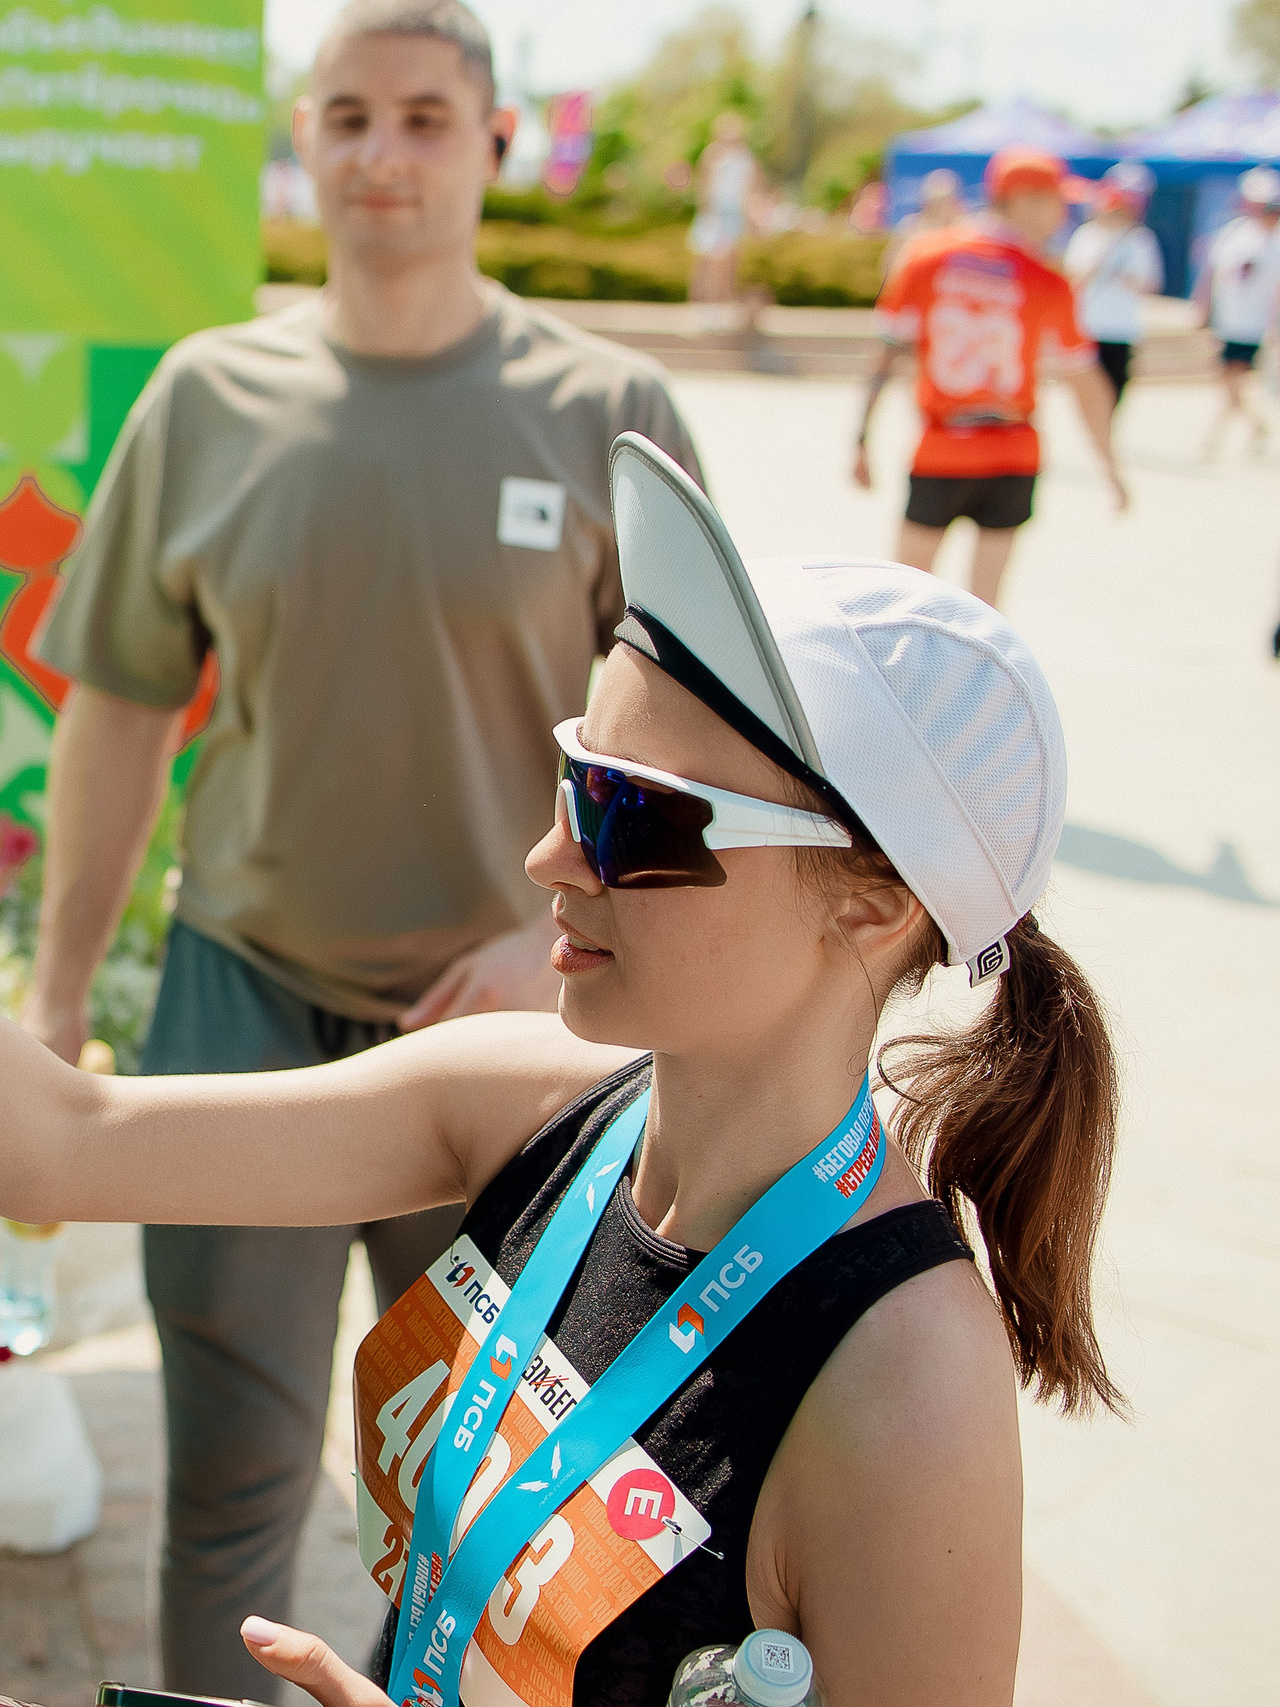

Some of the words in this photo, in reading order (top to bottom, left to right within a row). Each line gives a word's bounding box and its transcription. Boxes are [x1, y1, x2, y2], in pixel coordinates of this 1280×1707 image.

[812, 1120, 866, 1183] #БЕГОВАЯ
[834, 1141, 876, 1199] #СТРЕСС
[463, 1279, 500, 1324] ПСБ
[698, 1243, 764, 1313] ПСБ
[453, 1379, 497, 1452] ПСБ
[411, 1552, 429, 1607] #ЛЮБИ
[558, 1555, 590, 1594] НИШ
[423, 1609, 456, 1675] ПСБ
